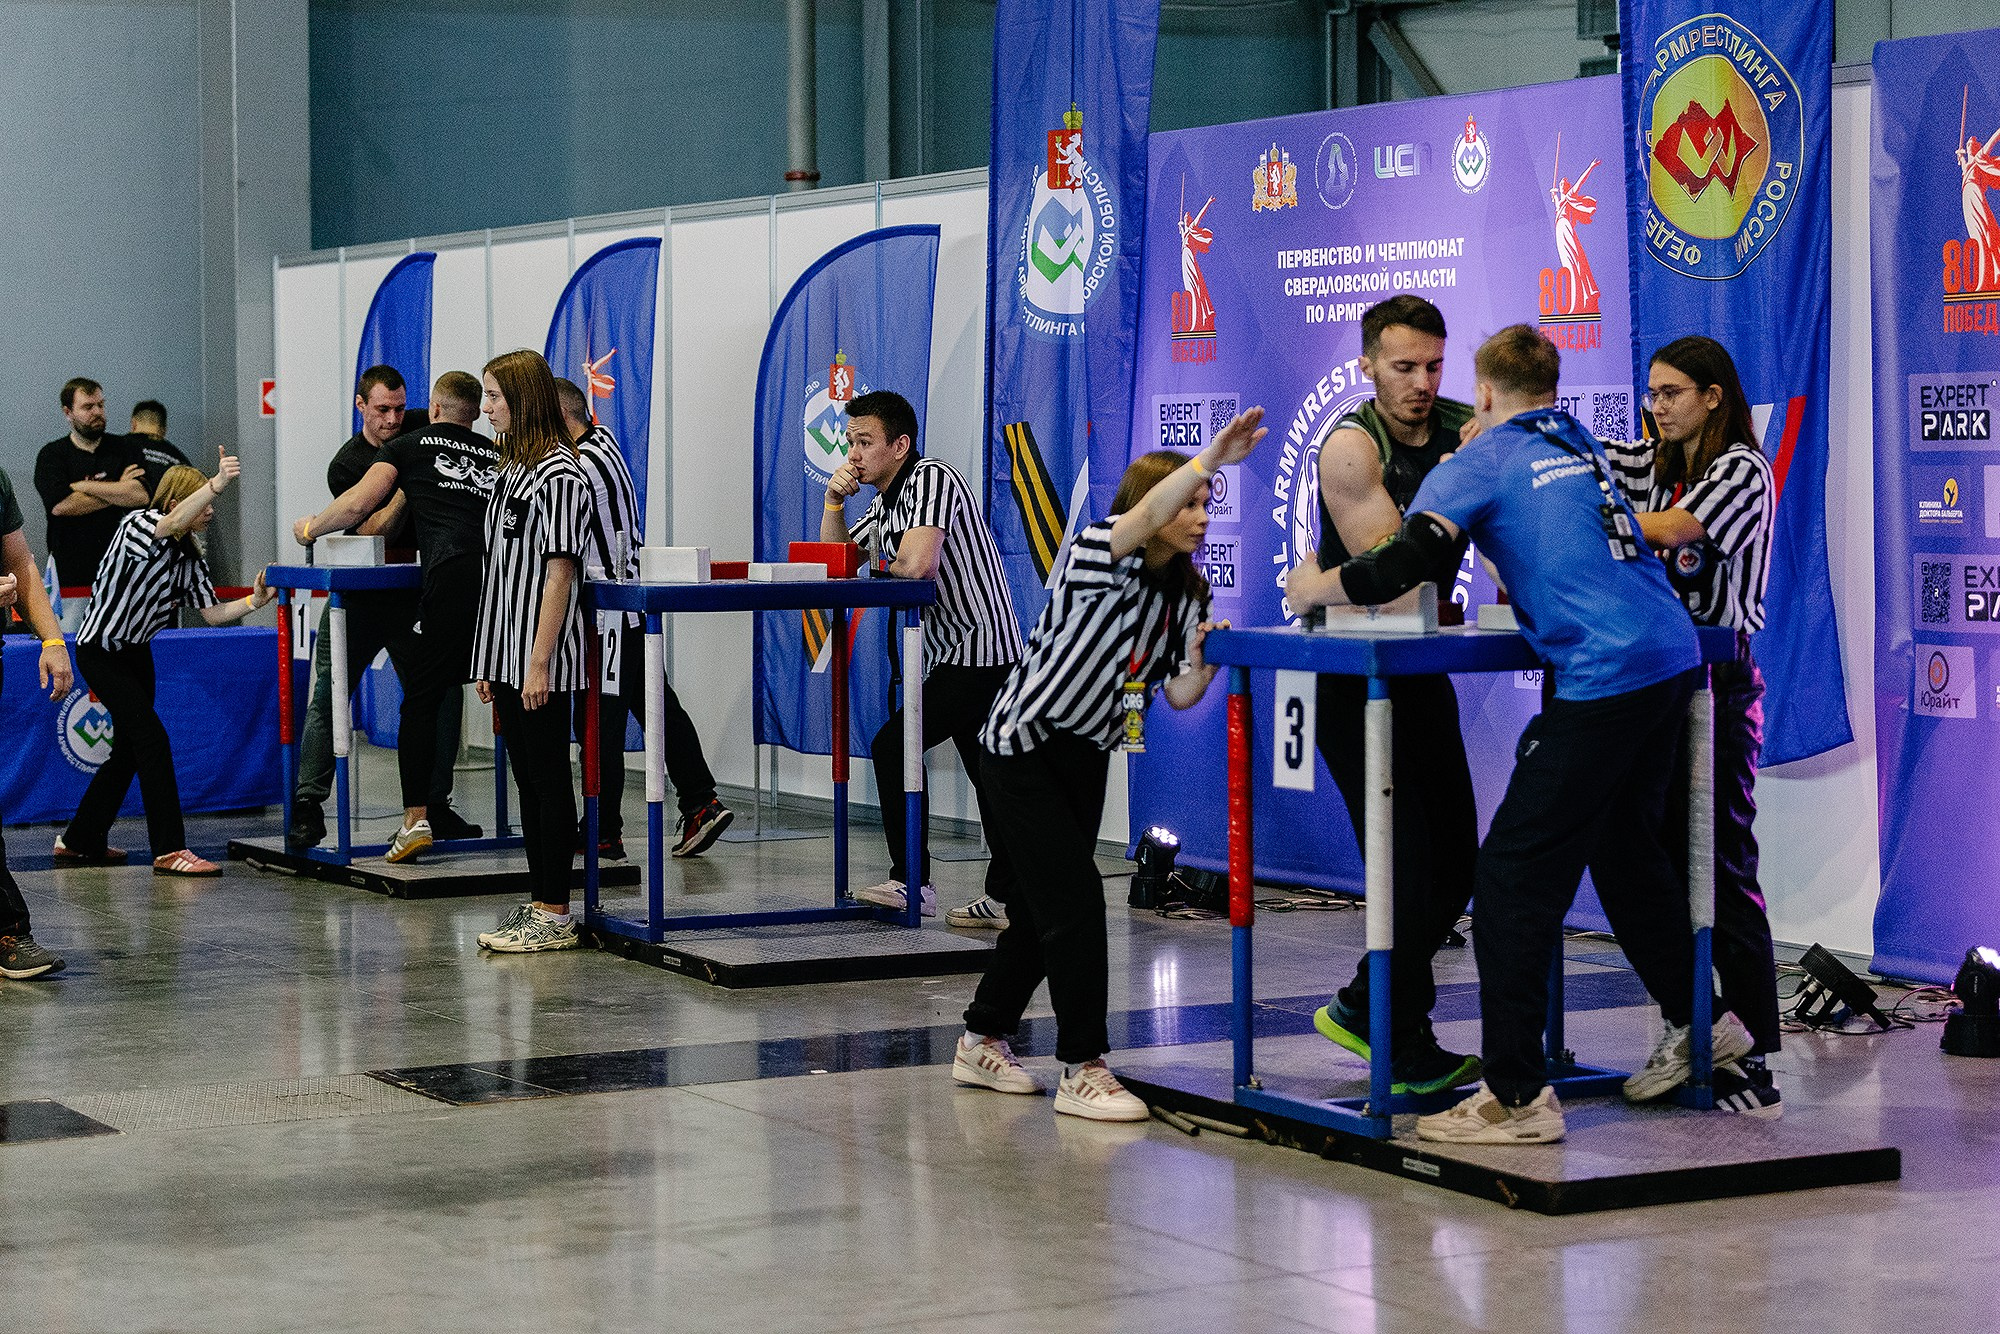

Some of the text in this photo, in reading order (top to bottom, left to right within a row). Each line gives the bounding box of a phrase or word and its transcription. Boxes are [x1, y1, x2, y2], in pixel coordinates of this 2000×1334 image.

[1277, 237, 1465, 269] ПЕРВЕНСТВО И ЧЕМПИОНАТ
[1942, 238, 1980, 293] 80
[1284, 267, 1457, 298] СВЕРДЛОВСКОЙ ОБЛАСТИ
[1539, 267, 1572, 315] 80
[1171, 291, 1193, 332] 80
[1305, 304, 1325, 324] ПО
[1943, 303, 2000, 336] ПОБЕД
[1160, 402, 1202, 421] EXPERT
[1920, 383, 1990, 409] EXPERT
[1161, 424, 1201, 445] PARK
[1922, 411, 1989, 439] PARK
[1272, 357, 1375, 531] ARMWREST
[1201, 564, 1233, 586] ARK
[298, 603, 305, 648] 1
[606, 628, 616, 681] 2
[1122, 693, 1145, 710] ORG
[1920, 690, 1961, 712] Юрайт
[1285, 697, 1304, 770] 3
